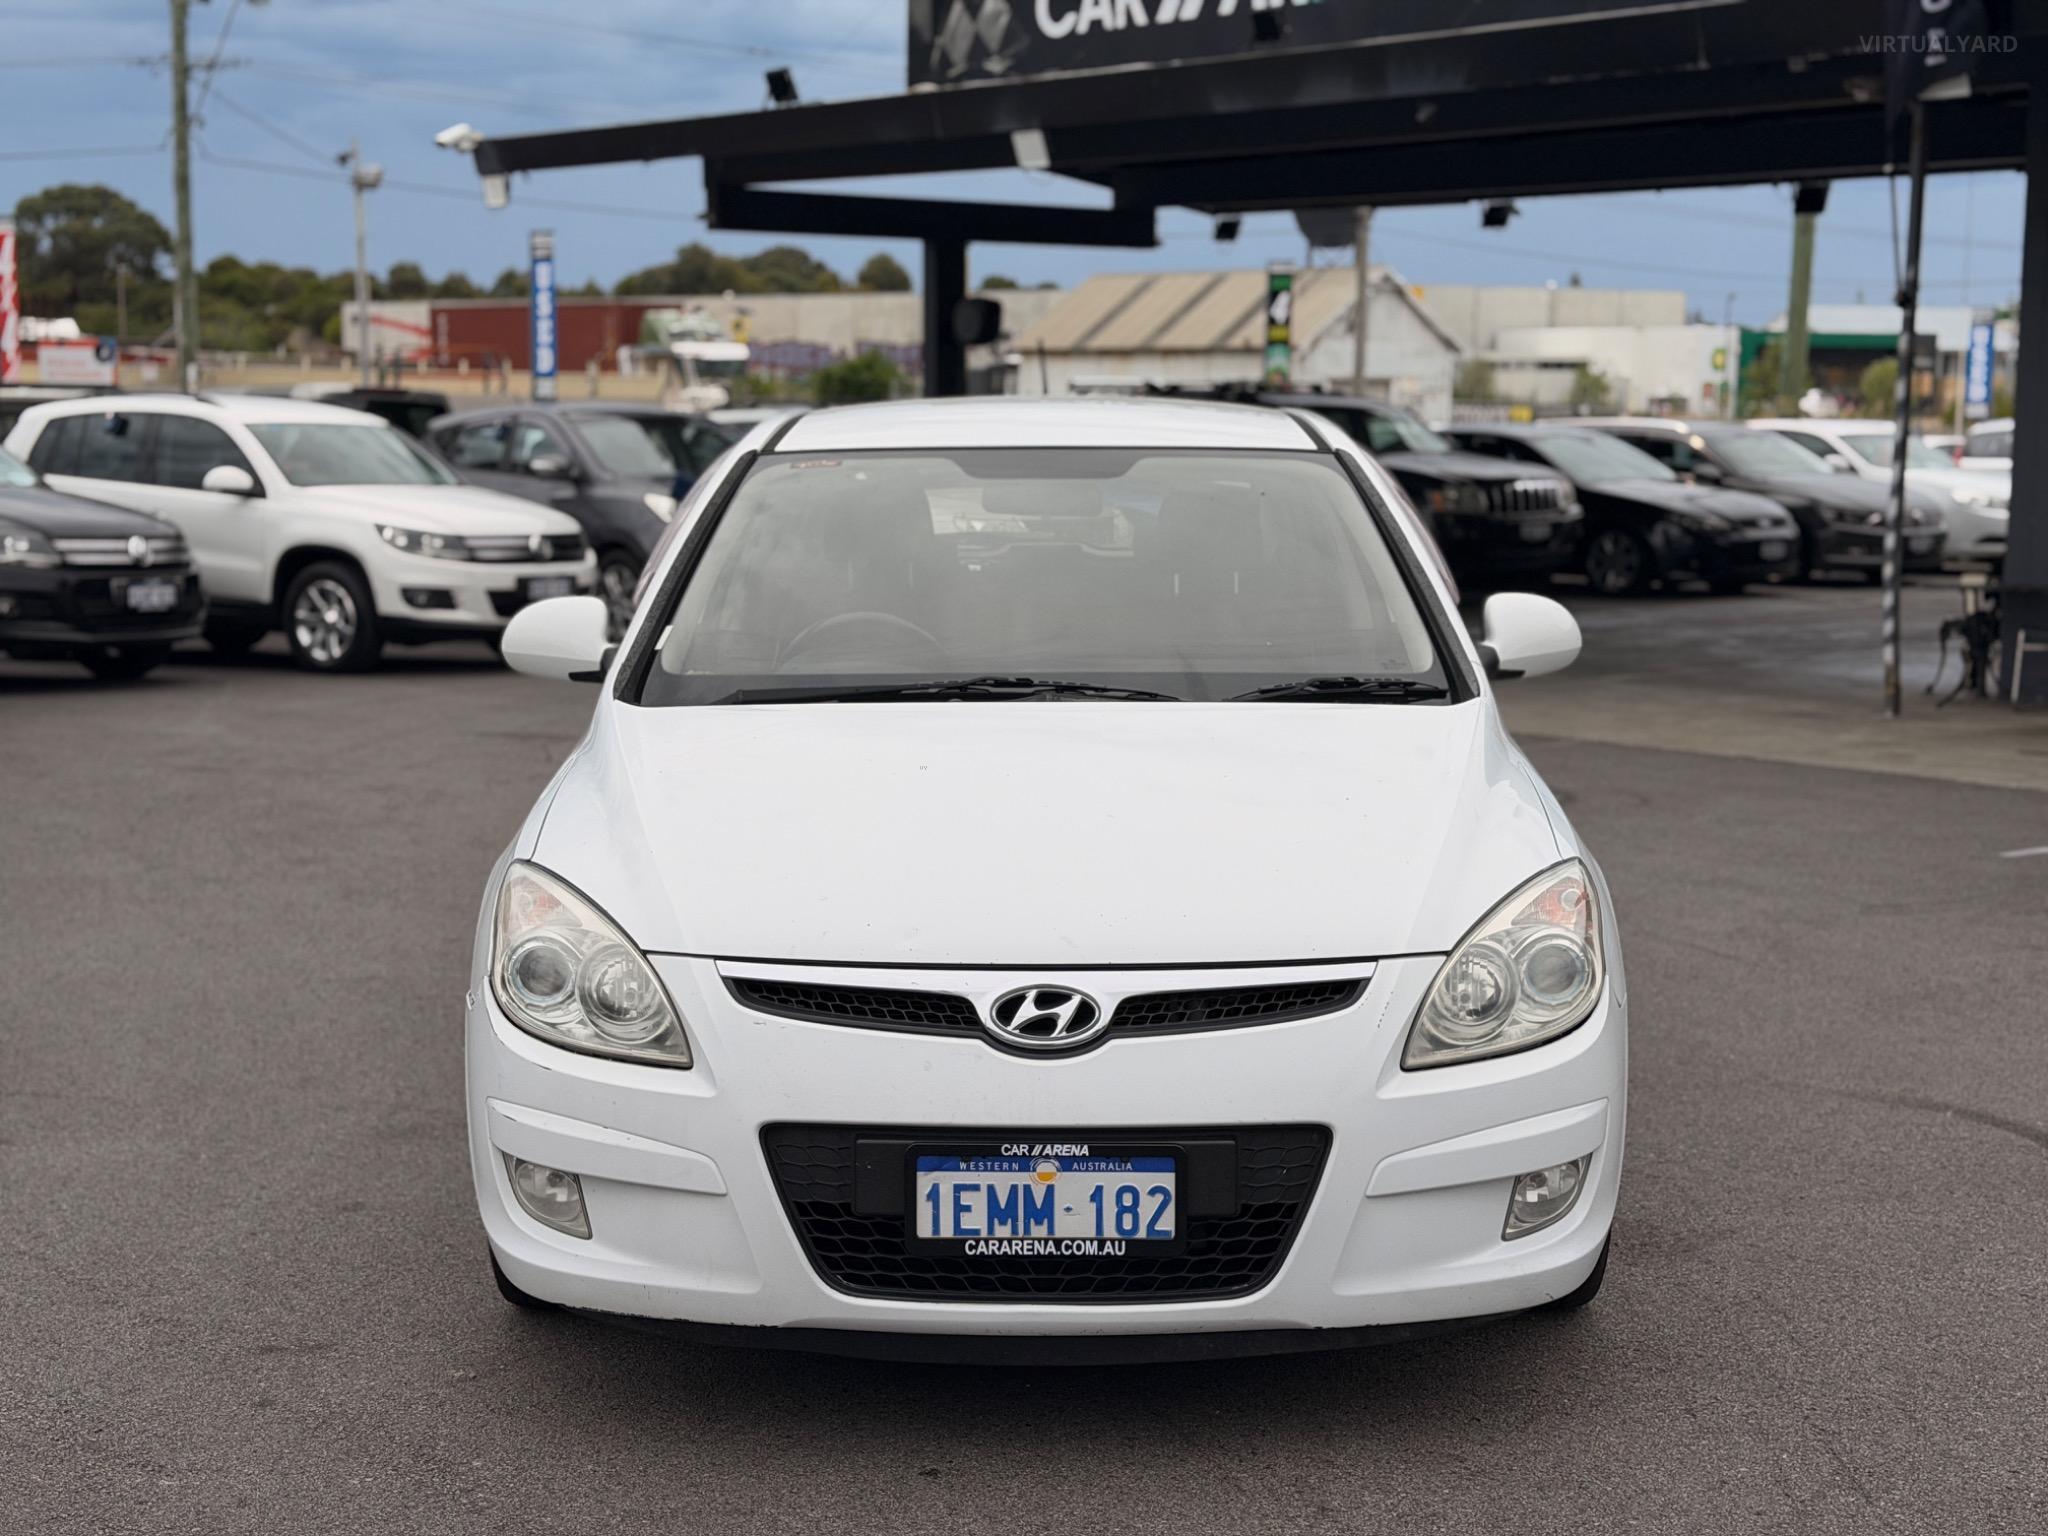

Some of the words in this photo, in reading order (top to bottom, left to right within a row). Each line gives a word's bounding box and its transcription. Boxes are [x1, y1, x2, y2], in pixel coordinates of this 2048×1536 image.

[959, 1162, 1020, 1172] WESTERN
[1072, 1162, 1133, 1172] AUSTRALIA
[964, 1240, 1126, 1256] CARARENA.COM.AU
